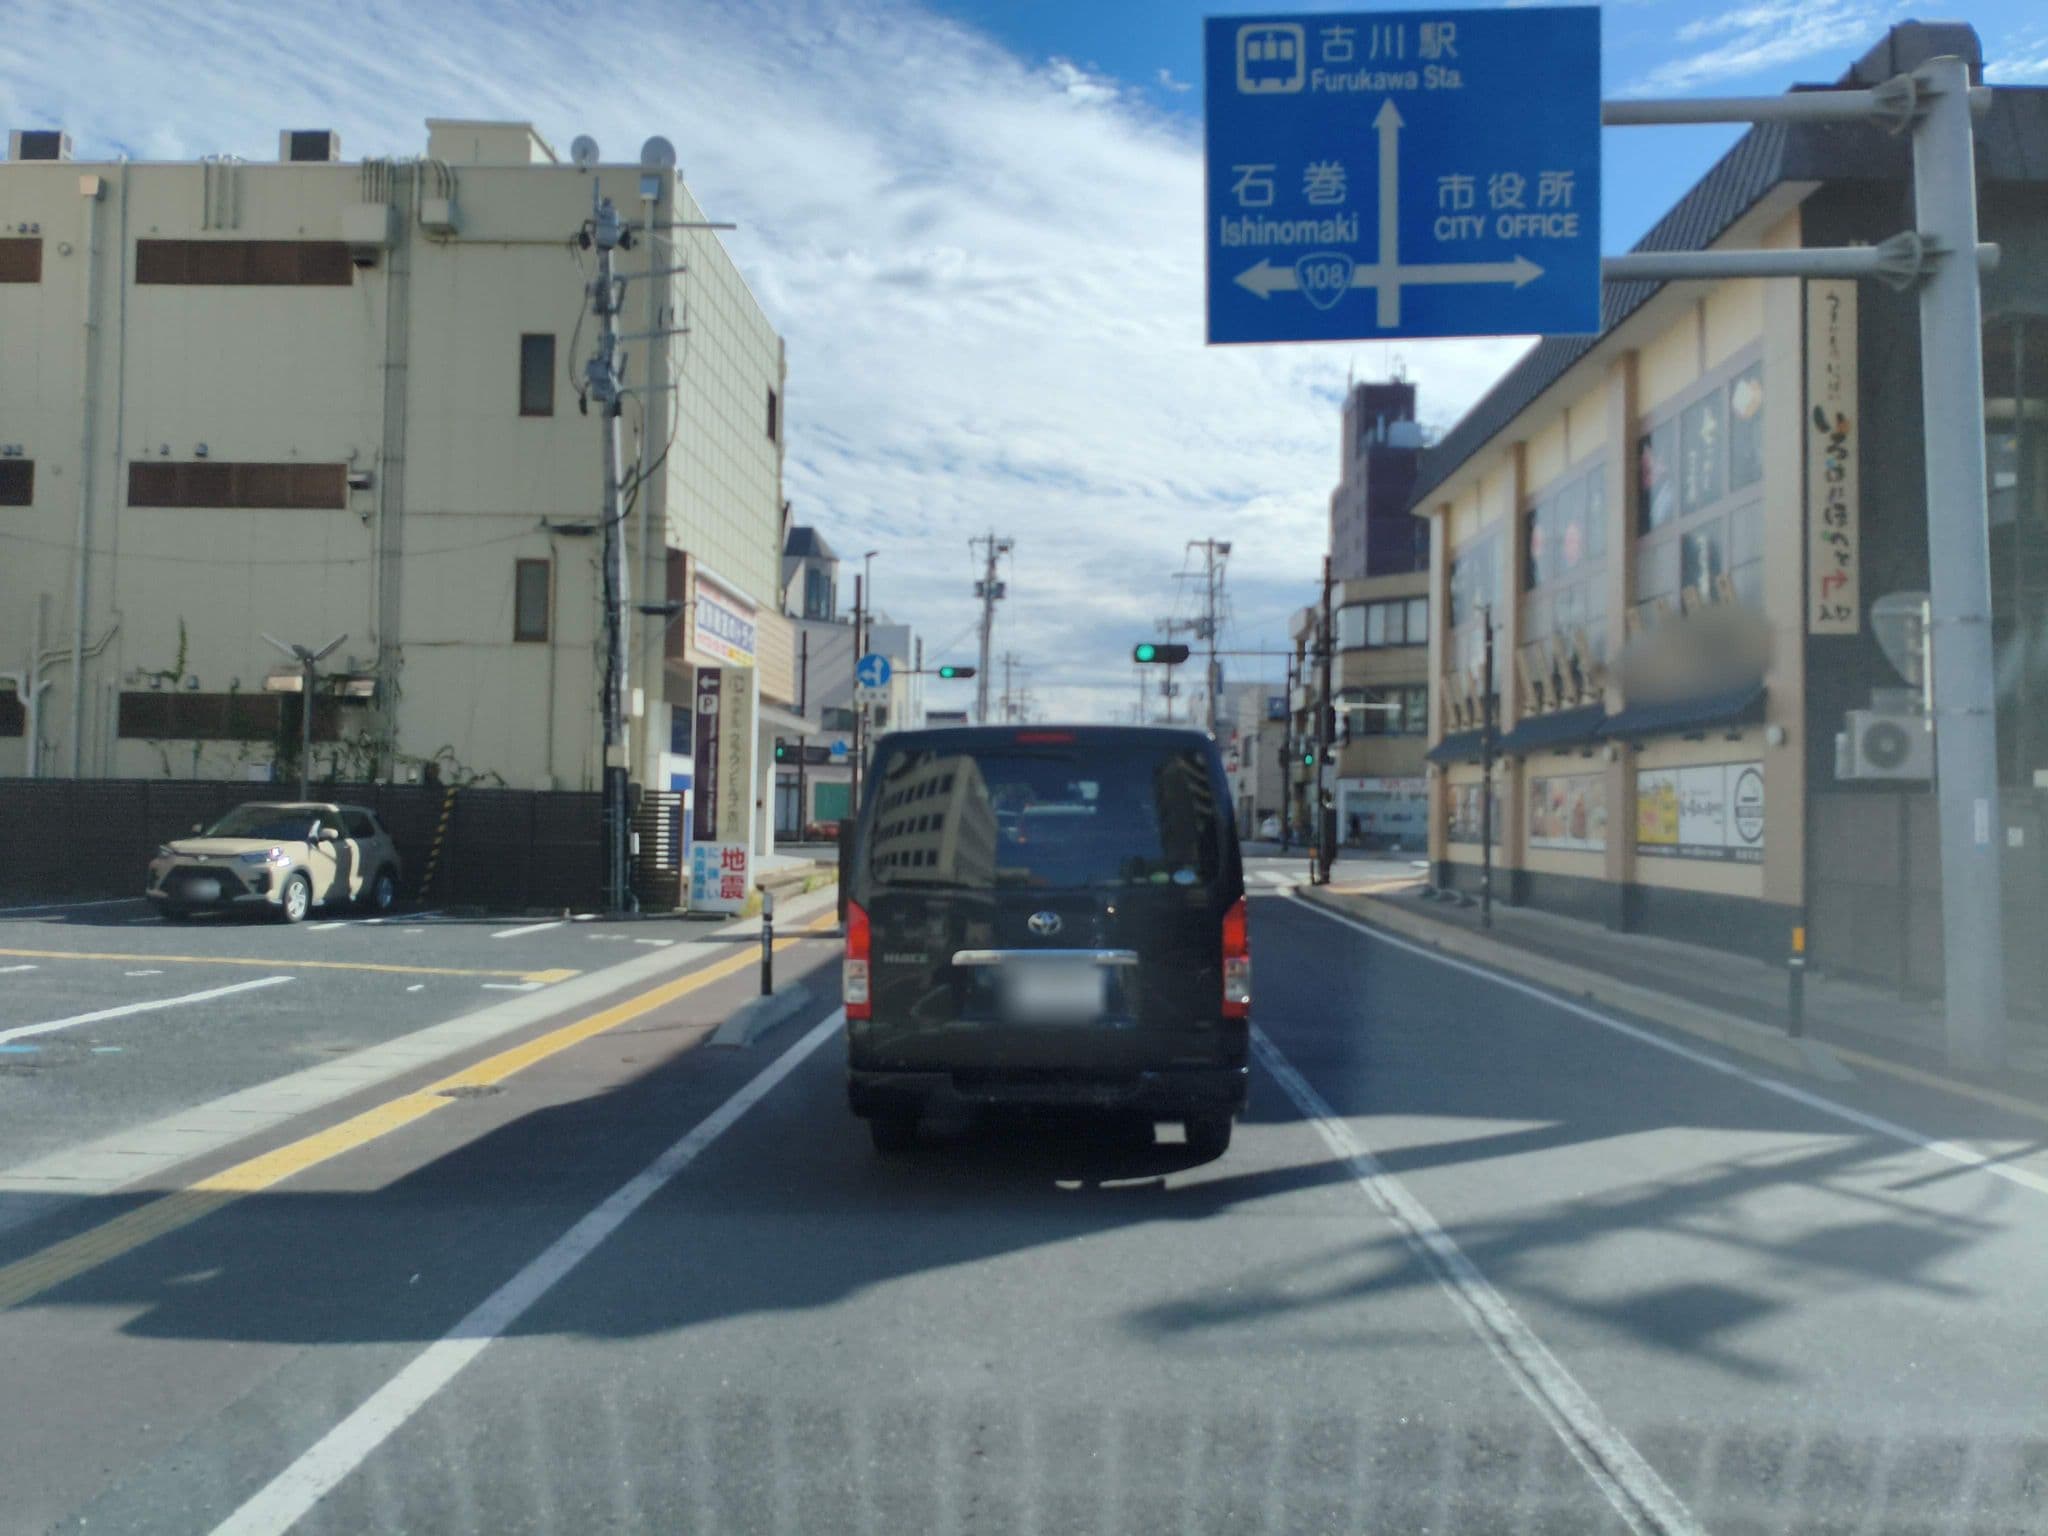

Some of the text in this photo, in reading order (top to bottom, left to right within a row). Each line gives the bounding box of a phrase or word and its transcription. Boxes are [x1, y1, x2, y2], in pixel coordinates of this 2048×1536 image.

[1319, 22, 1458, 63] 古川駅
[1311, 67, 1419, 92] Furukawa
[1231, 160, 1347, 207] 石巻
[1437, 170, 1575, 210] 市役所
[1221, 212, 1358, 247] Ishinomaki
[1434, 213, 1578, 241] CITY OFFICE
[1305, 263, 1344, 289] 108
[720, 846, 745, 900] 地震
